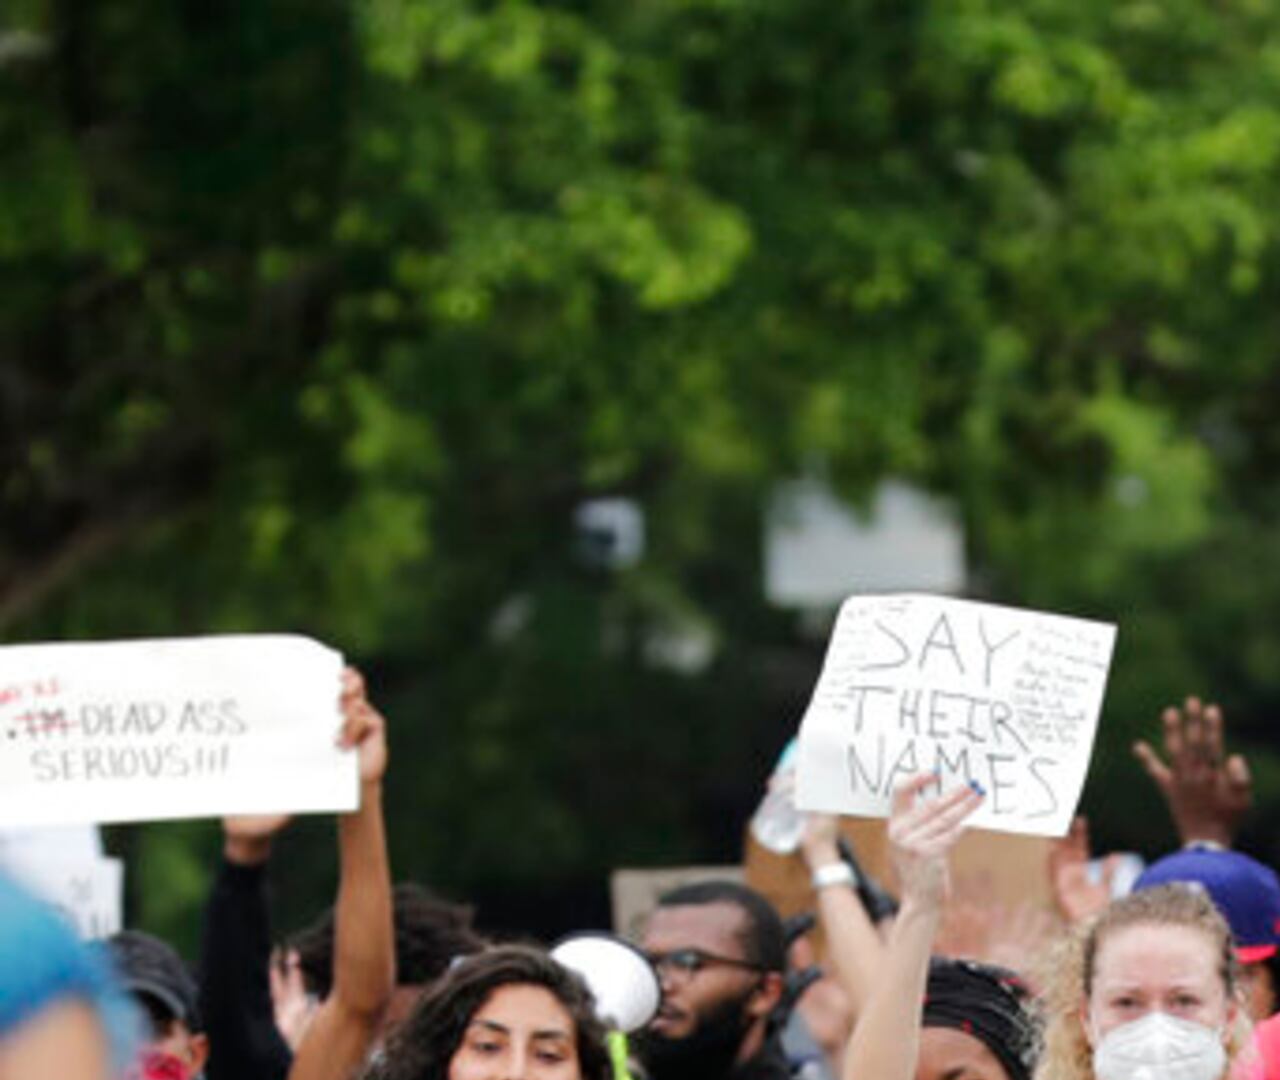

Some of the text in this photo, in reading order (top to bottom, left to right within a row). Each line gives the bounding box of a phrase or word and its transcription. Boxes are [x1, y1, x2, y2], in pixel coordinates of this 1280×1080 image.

[857, 611, 1022, 688] SAY
[80, 699, 168, 737] DEAD
[177, 698, 248, 738] ASS
[848, 684, 1032, 754] THEIR
[29, 743, 230, 783] SERIOUS!!!
[848, 734, 1059, 819] NAMES
